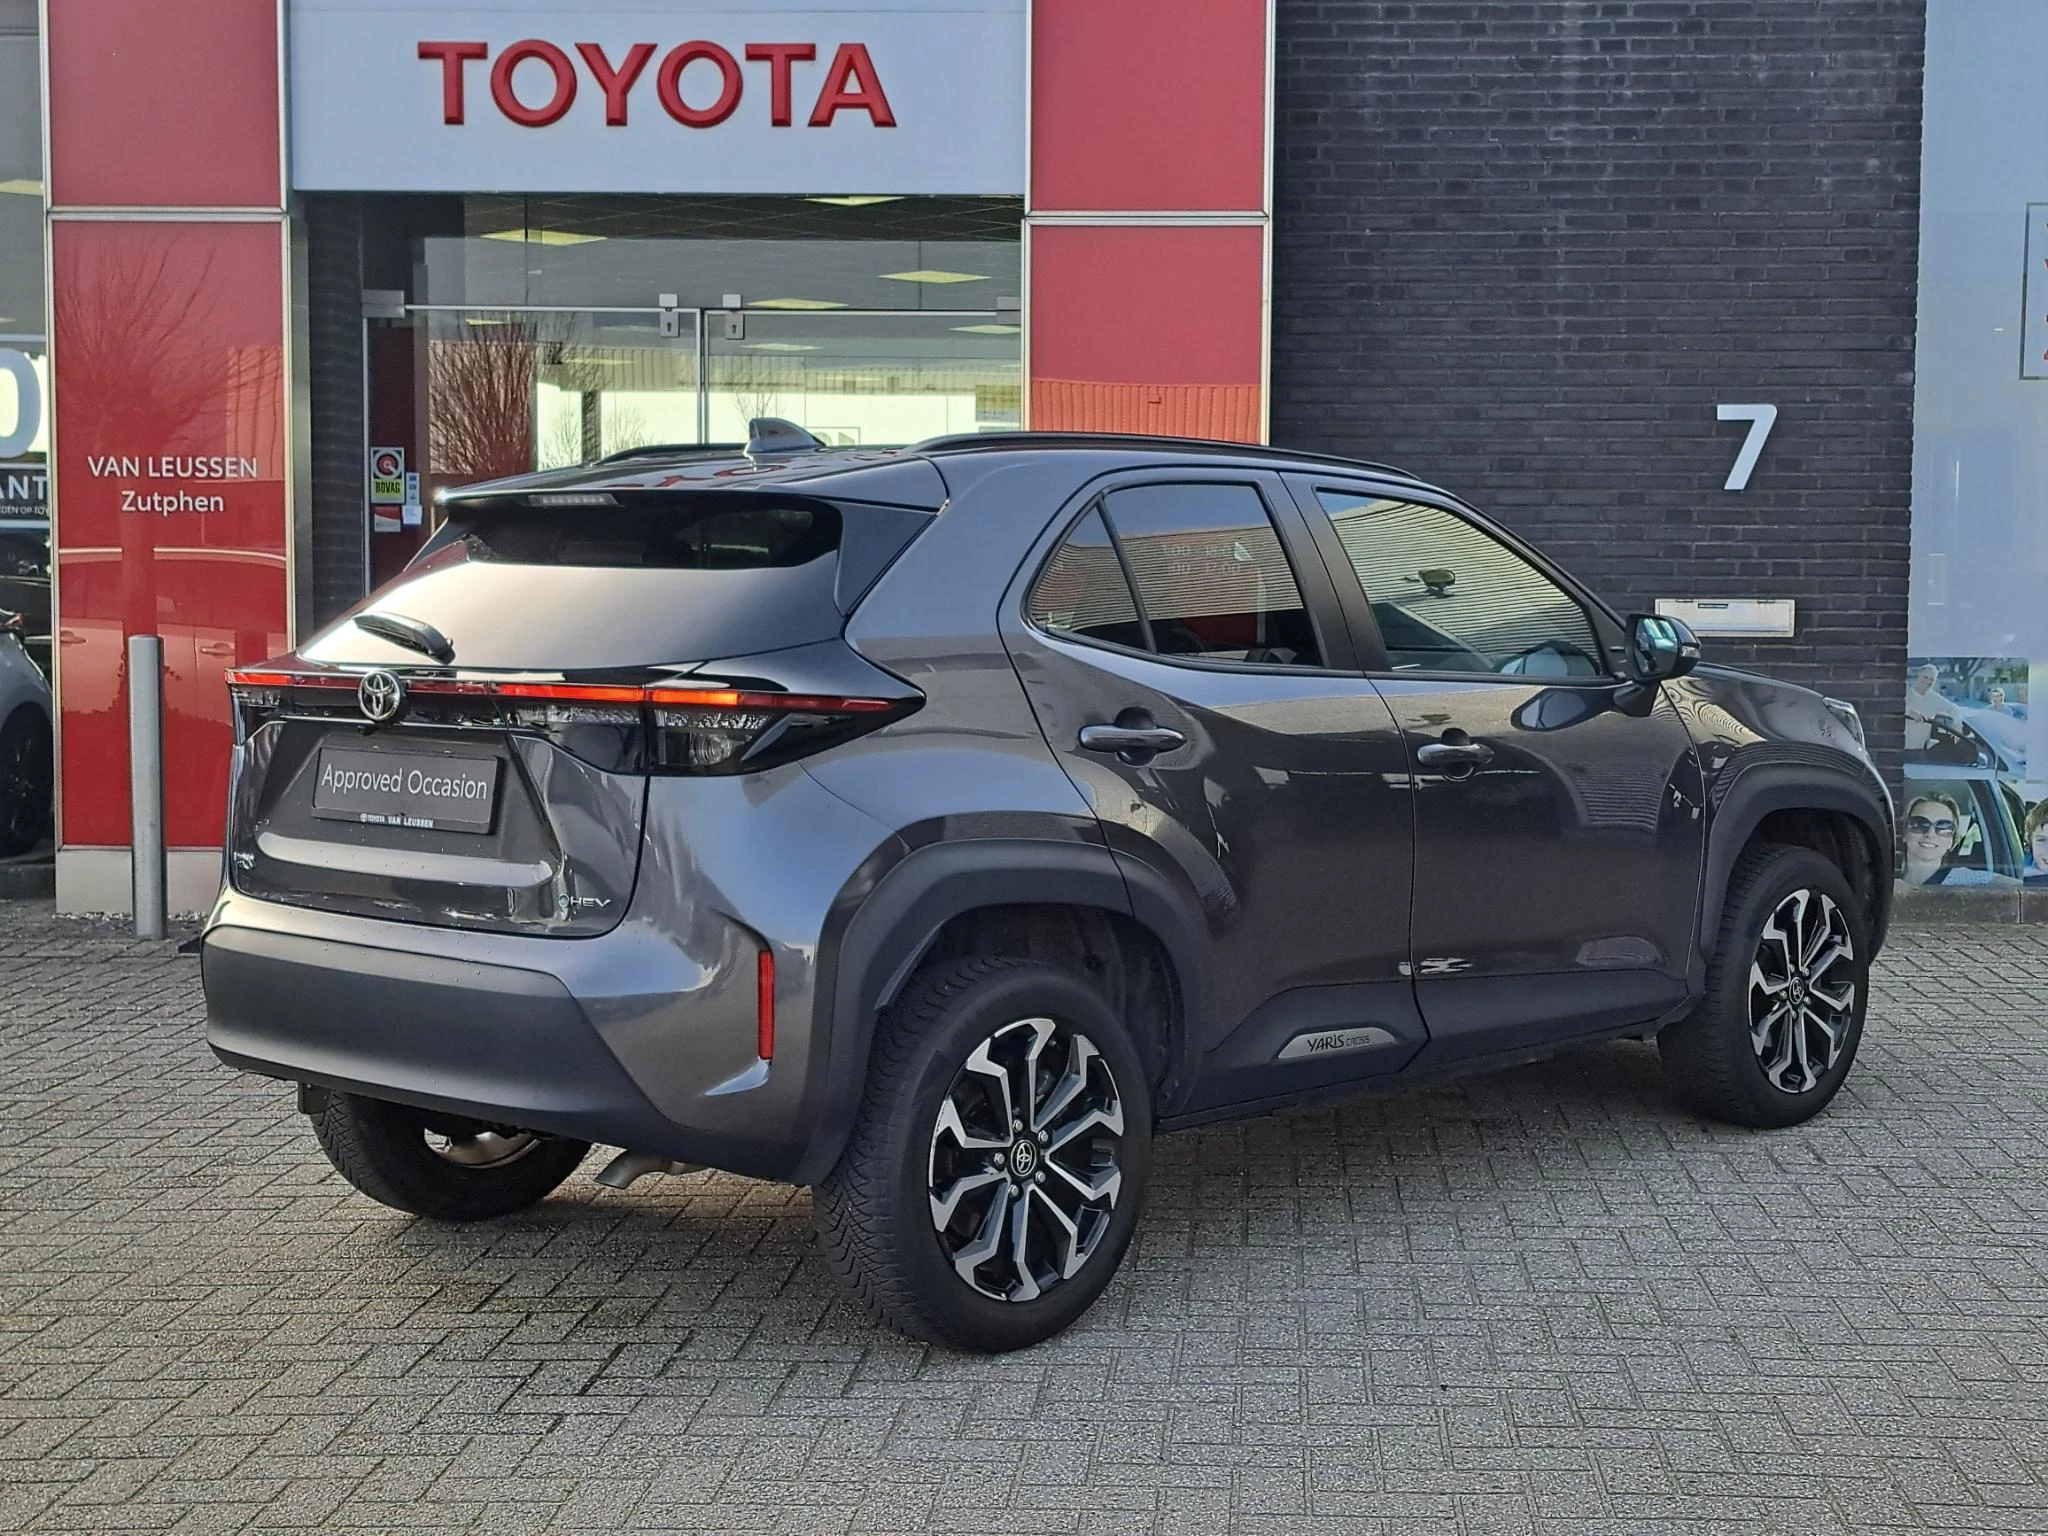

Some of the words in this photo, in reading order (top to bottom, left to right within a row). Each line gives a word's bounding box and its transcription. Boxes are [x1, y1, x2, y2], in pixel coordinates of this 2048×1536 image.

[418, 39, 898, 129] TOYOTA
[1717, 404, 1778, 490] 7
[88, 456, 140, 477] VAN
[149, 456, 257, 478] LEUSSEN
[0, 474, 47, 500] NT
[375, 481, 401, 493] BOVAG
[121, 490, 224, 517] Zutphen
[322, 763, 403, 795] Approved
[407, 769, 488, 800] Occasion
[388, 815, 401, 825] VAN
[404, 817, 434, 829] LEUSSEN
[570, 896, 611, 907] HEV
